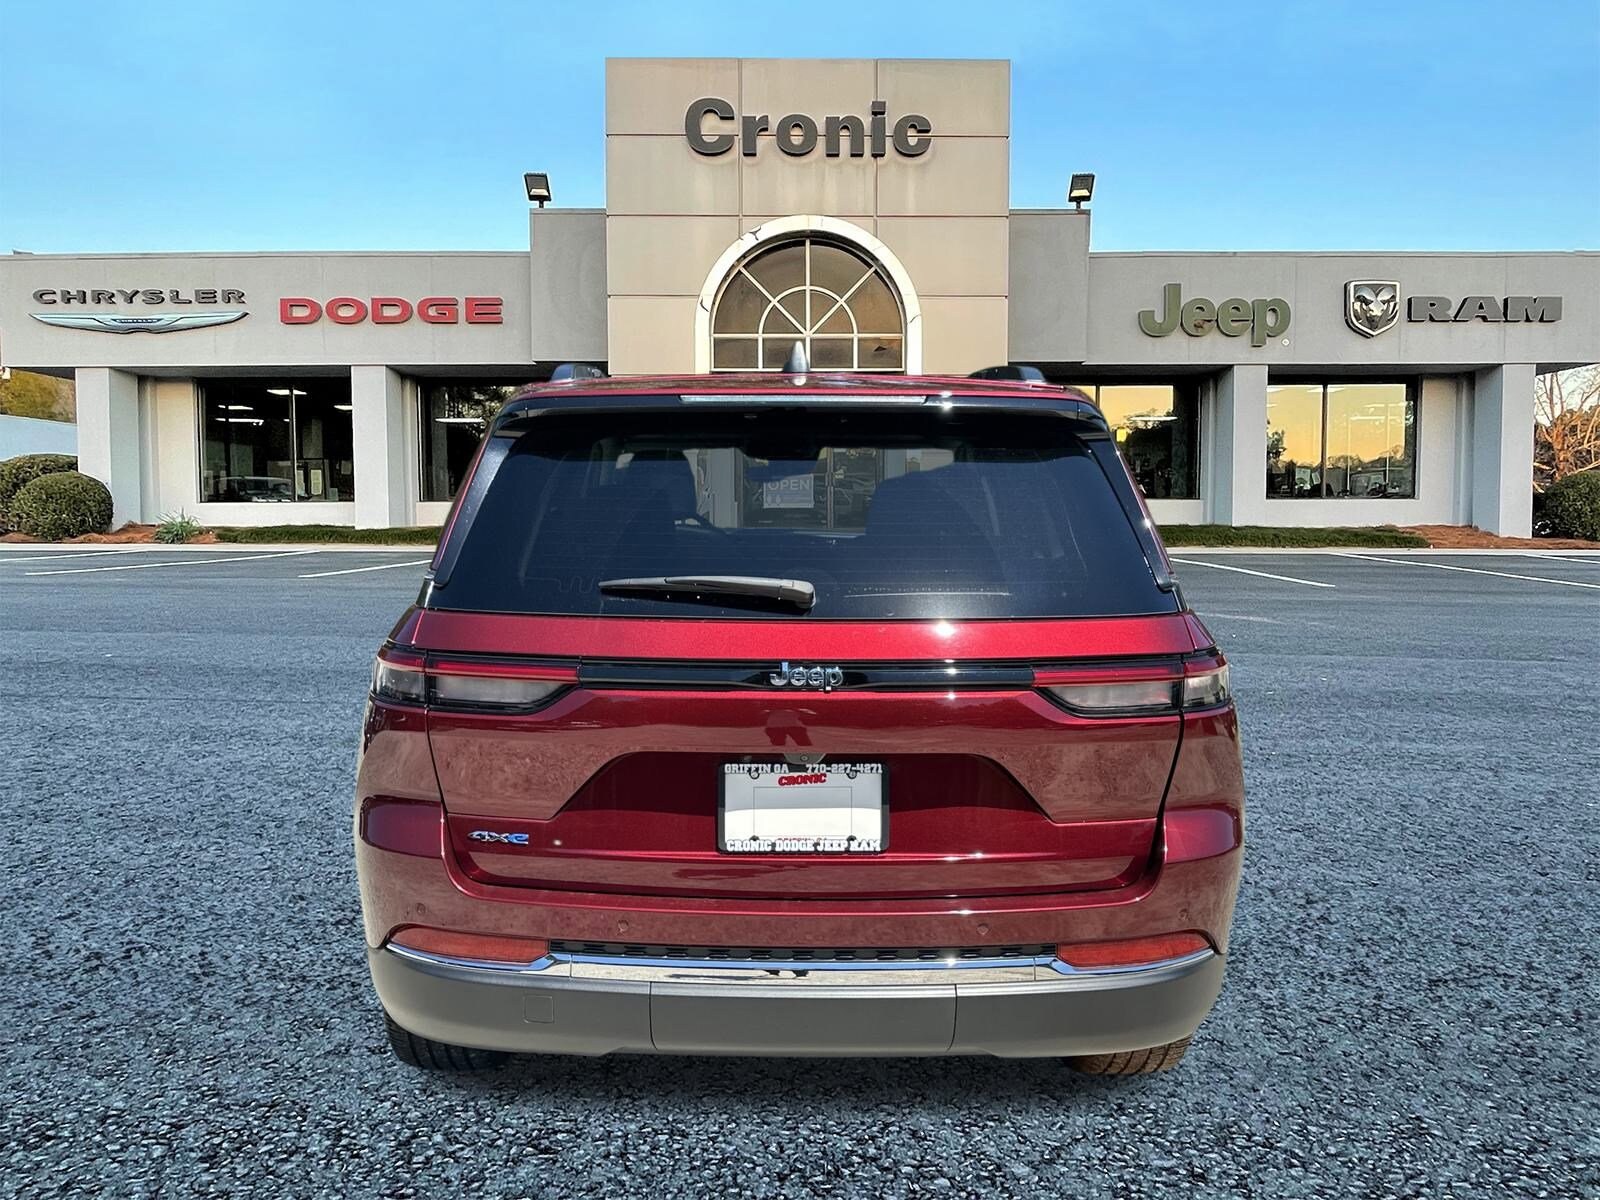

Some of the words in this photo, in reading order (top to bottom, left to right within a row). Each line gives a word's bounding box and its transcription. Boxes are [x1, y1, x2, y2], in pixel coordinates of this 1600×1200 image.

[685, 97, 932, 157] Cronic
[32, 288, 247, 305] CHRYSLER
[1408, 296, 1562, 322] RAM
[280, 296, 504, 325] DODGE
[1138, 283, 1291, 347] Jeep
[769, 661, 844, 692] Jeep
[724, 763, 771, 773] GRIFFIN
[778, 773, 827, 786] CRONIC
[726, 840, 772, 852] CRONIC
[775, 840, 815, 852] DODGE
[817, 840, 848, 852] JEEP
